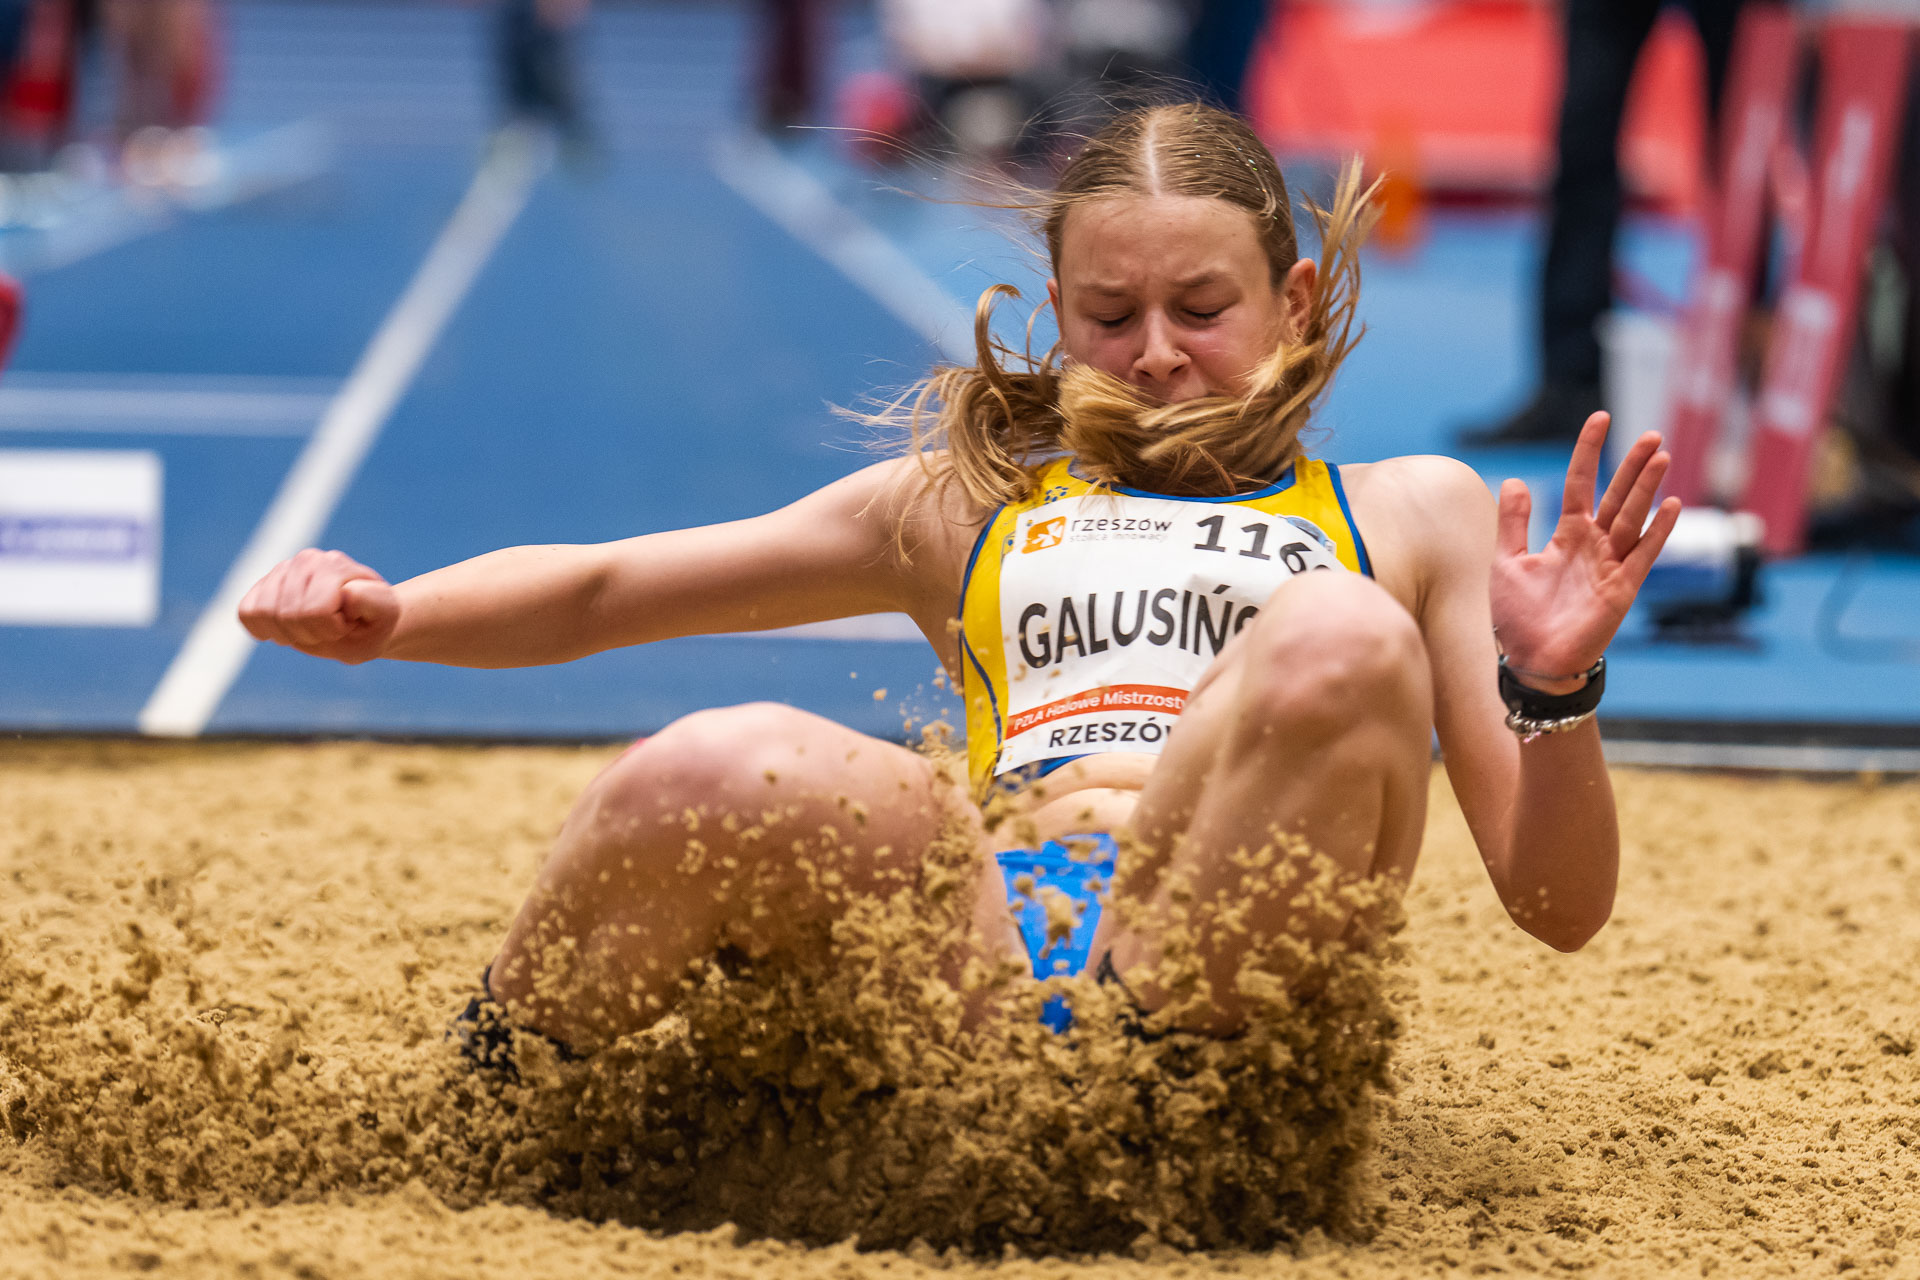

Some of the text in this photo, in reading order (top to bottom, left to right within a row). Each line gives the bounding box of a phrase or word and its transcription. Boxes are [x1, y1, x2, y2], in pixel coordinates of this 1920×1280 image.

[1070, 518, 1173, 532] rzeszów
[1194, 514, 1332, 575] 116
[1013, 710, 1044, 731] PZLA
[1046, 696, 1100, 718] Halowe
[1049, 716, 1172, 748] RZESZÓ
